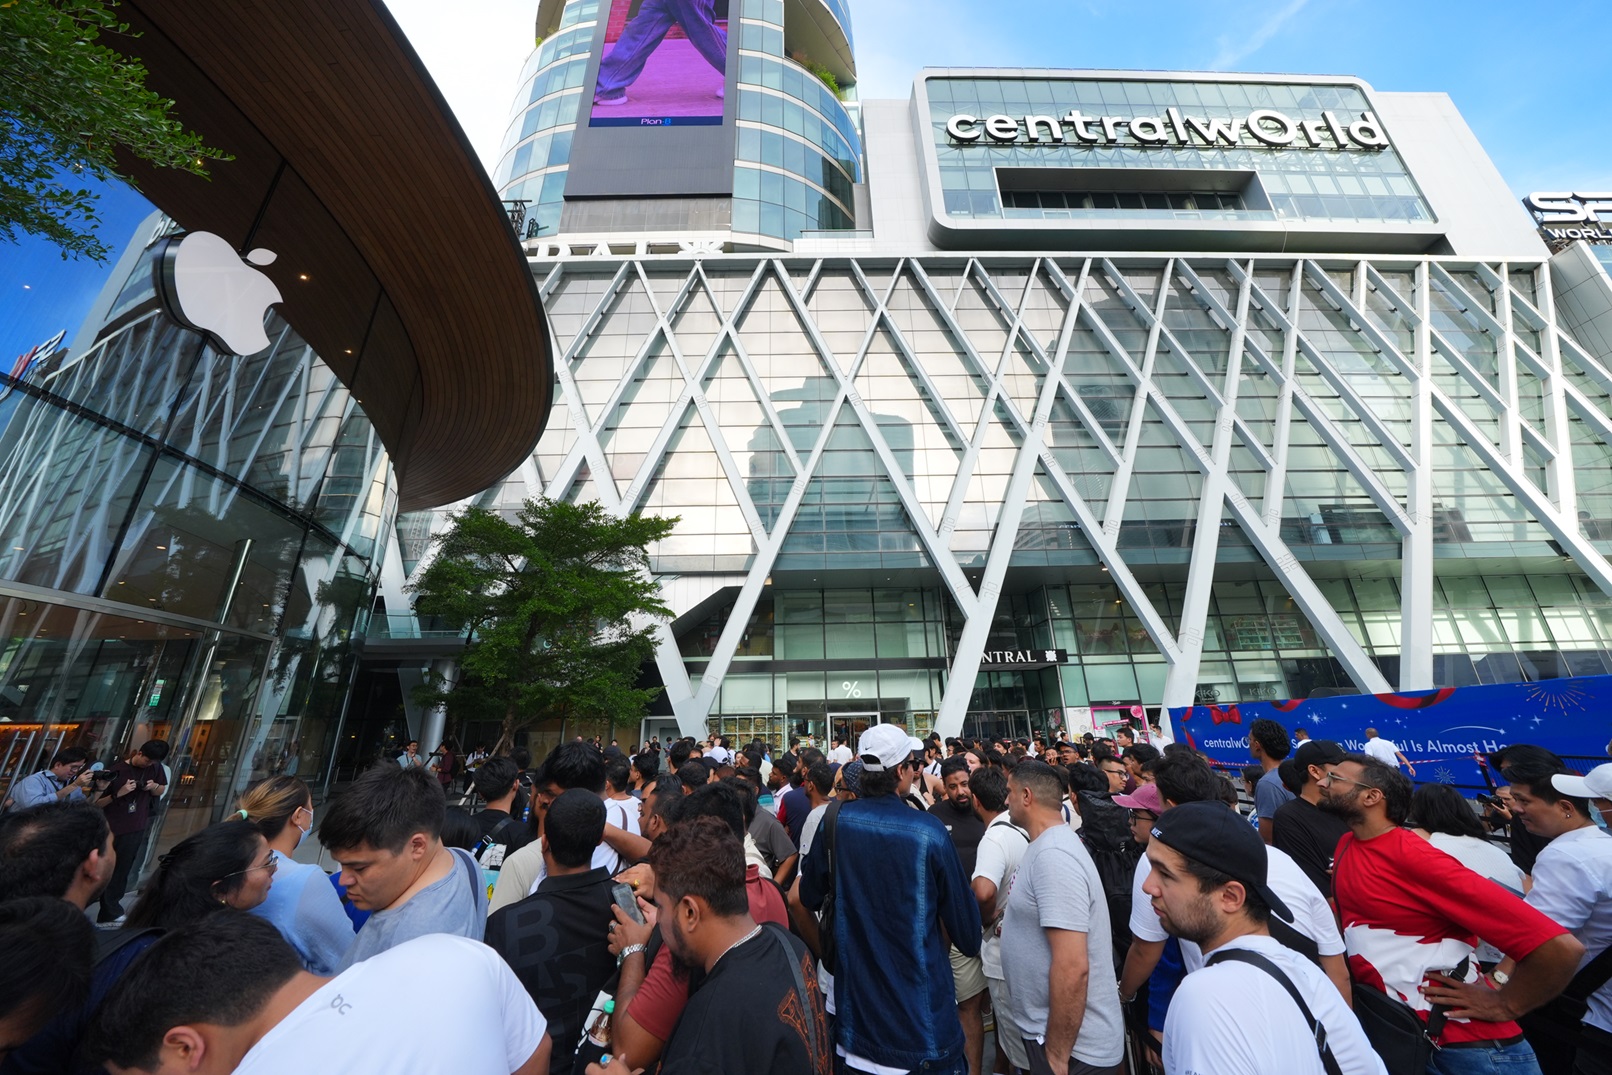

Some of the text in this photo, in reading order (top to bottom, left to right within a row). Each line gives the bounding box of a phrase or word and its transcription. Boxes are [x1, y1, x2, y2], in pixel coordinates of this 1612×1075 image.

[946, 107, 1389, 150] centralwOrld
[982, 650, 1037, 663] NTRAL
[1204, 737, 1250, 749] centralwO
[1411, 739, 1424, 752] Is
[1427, 740, 1479, 754] Almost
